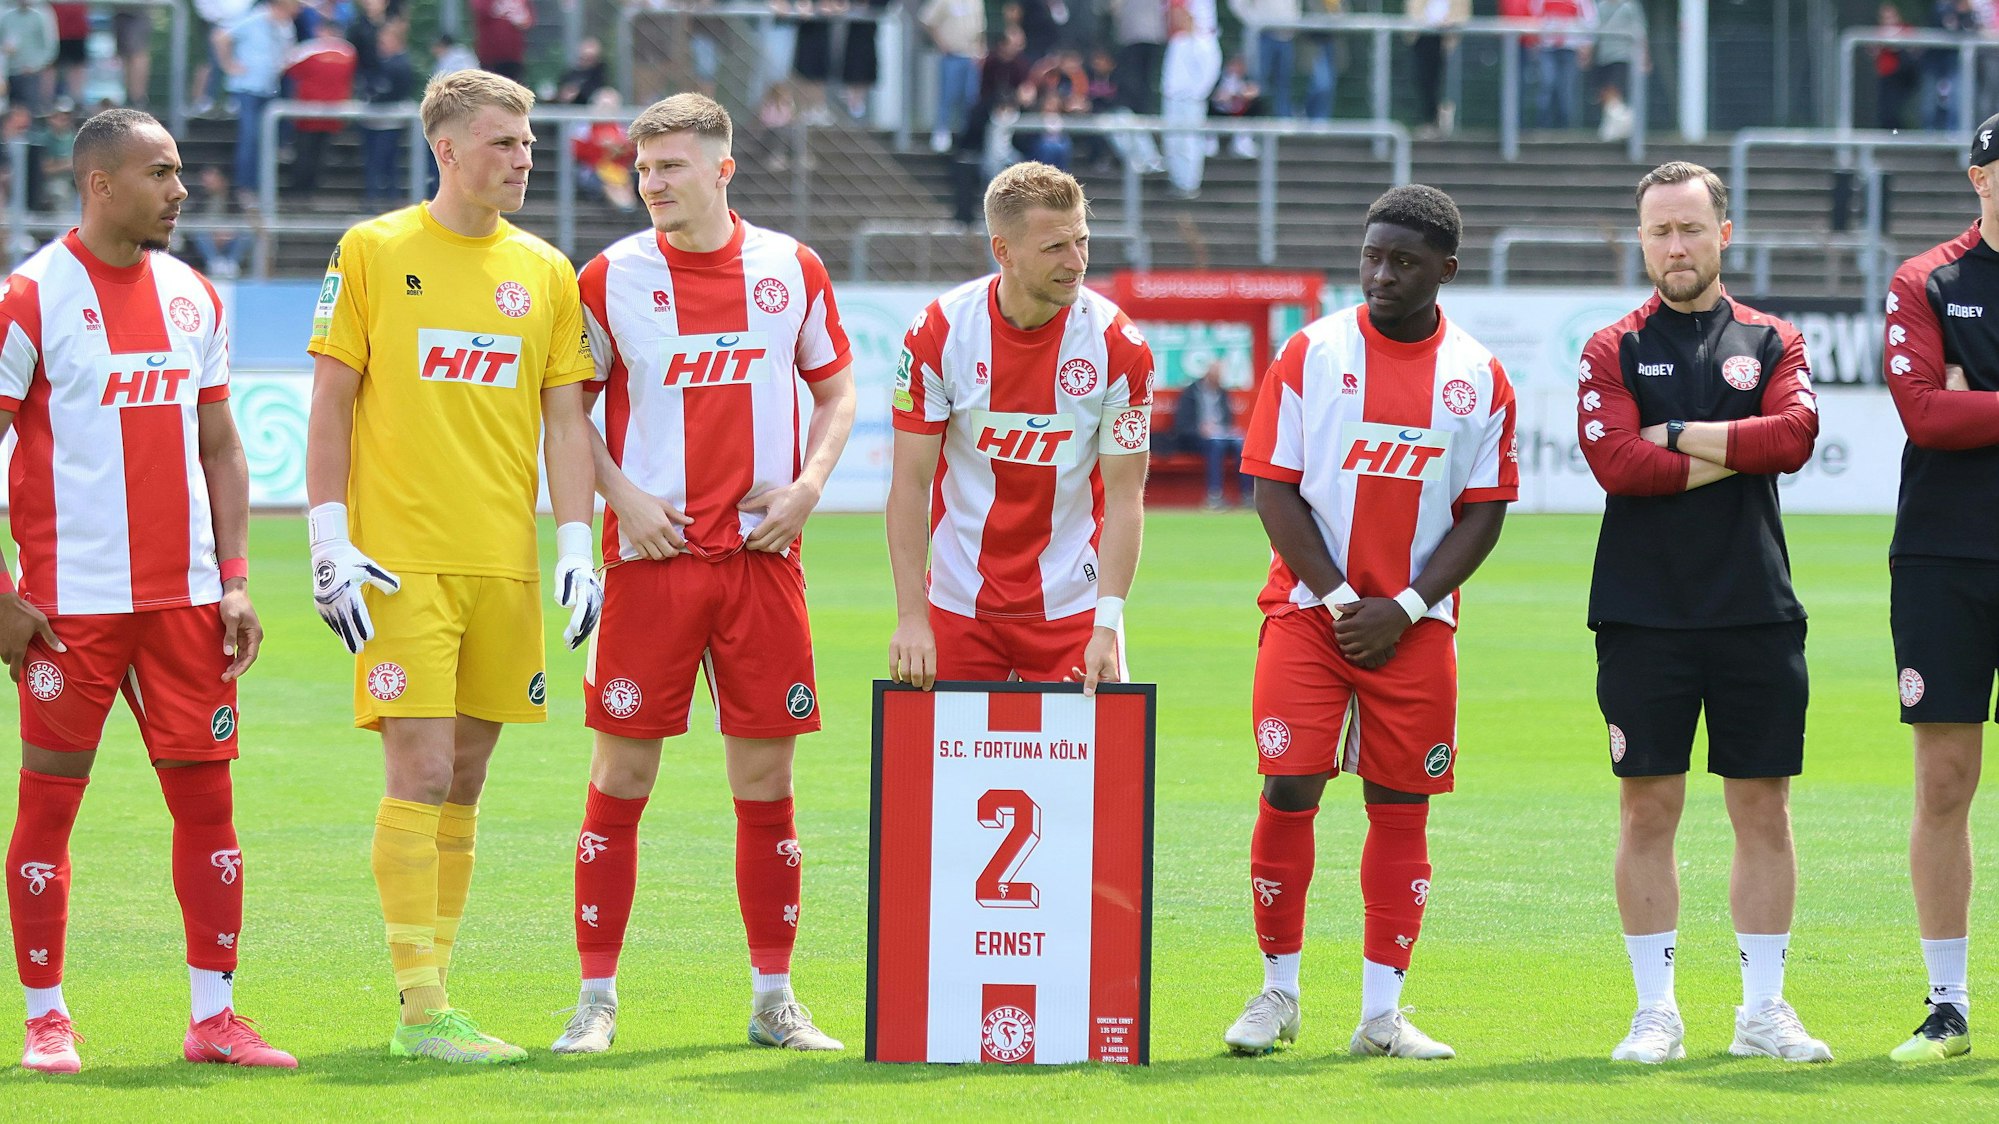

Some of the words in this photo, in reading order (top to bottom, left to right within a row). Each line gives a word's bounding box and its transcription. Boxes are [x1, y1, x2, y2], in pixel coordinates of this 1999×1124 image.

[500, 282, 530, 306] FORTUNA
[757, 280, 787, 302] FORTUNA
[1947, 303, 1983, 318] ROBEY
[422, 347, 517, 383] HIT
[664, 349, 766, 386] HIT
[1064, 360, 1096, 385] FORTUNA
[1638, 362, 1674, 377] ROBEY
[100, 369, 190, 406] HIT
[1065, 385, 1090, 395] KÖLN
[1447, 381, 1475, 404] FORTUNA
[977, 427, 1073, 463] HIT
[1341, 439, 1446, 476] HIT
[37, 664, 61, 696] FORTUNA
[373, 664, 405, 687] FORTUNA
[608, 681, 639, 706] FORTUNA
[1260, 720, 1288, 743] FORTUNA
[940, 740, 967, 758] S.C.
[974, 741, 1042, 759] FORTUNA
[1050, 739, 1087, 760] KÖLN
[975, 789, 1041, 909] 2
[975, 931, 1046, 957] ERNST
[988, 1008, 1033, 1042] FORTUNA
[991, 1045, 1027, 1059] KÖLN
